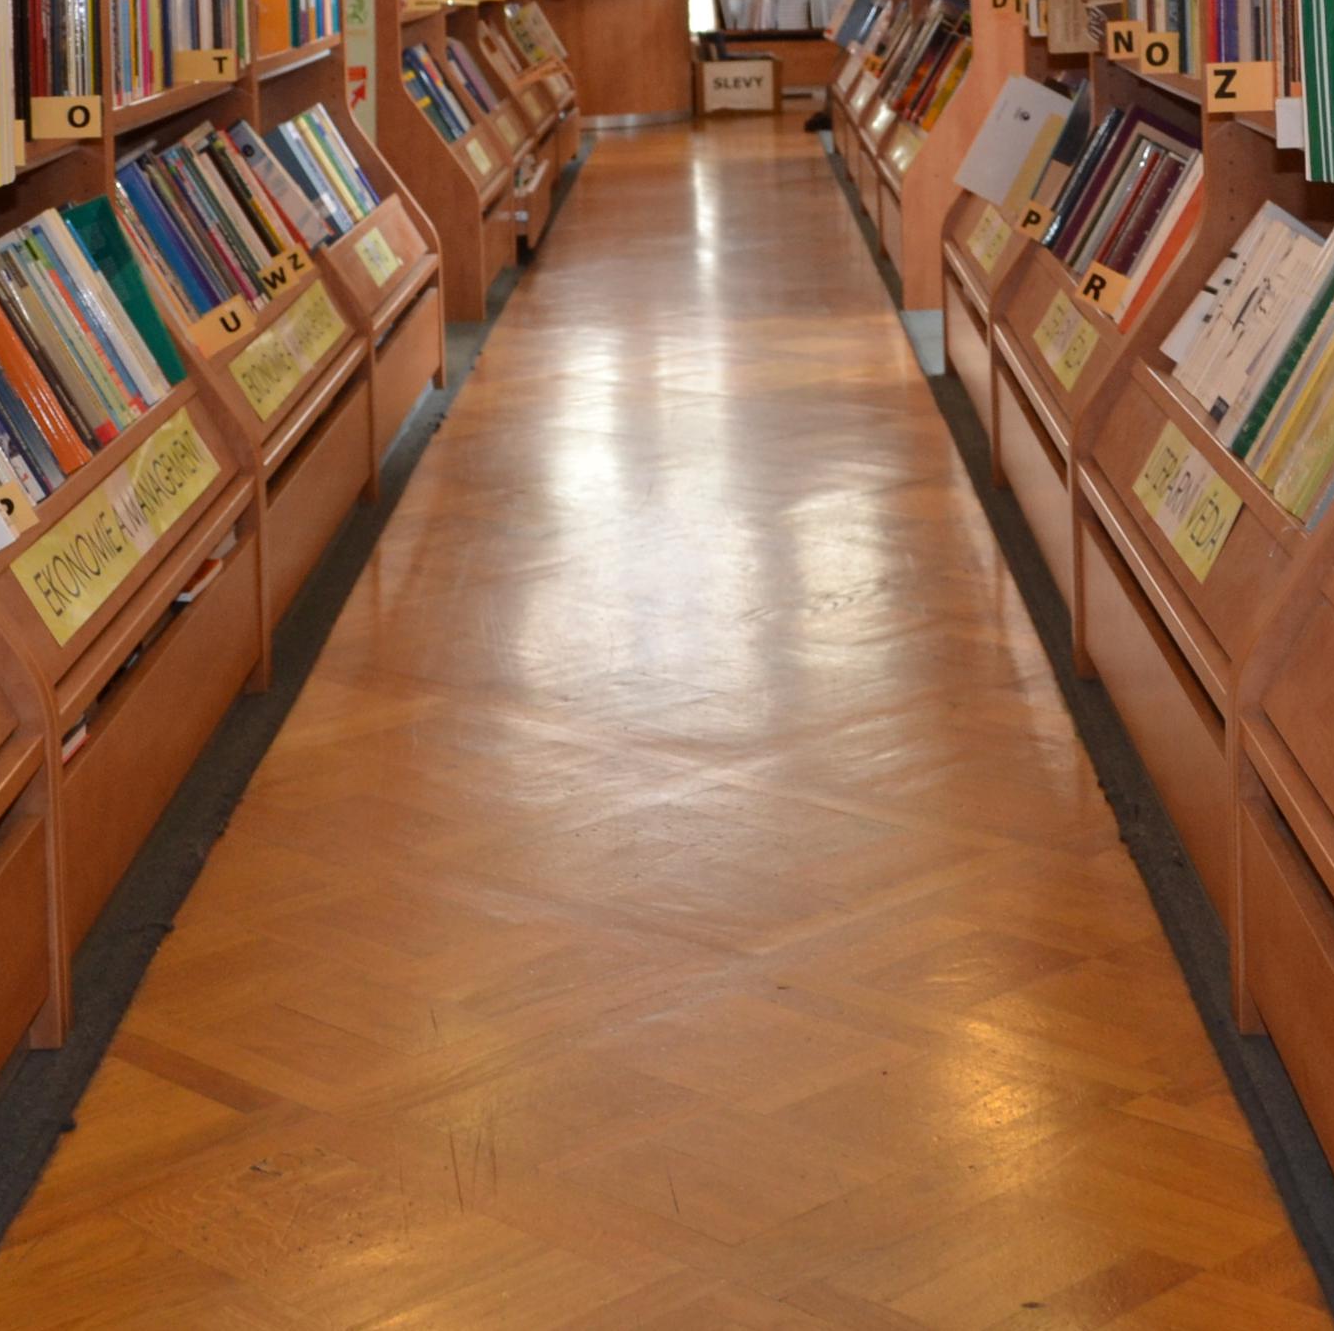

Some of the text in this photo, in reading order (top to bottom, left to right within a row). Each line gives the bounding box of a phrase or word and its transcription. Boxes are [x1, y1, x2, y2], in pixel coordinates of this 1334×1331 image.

[1113, 31, 1134, 53] N
[213, 56, 228, 75] T
[1146, 42, 1169, 67] O
[713, 76, 765, 92] SLEVY
[1213, 70, 1237, 100] Z
[67, 106, 90, 130] O
[1021, 212, 1041, 230] P
[290, 254, 305, 271] Z
[264, 267, 287, 300] W
[1082, 277, 1107, 302] R
[221, 315, 241, 335] U
[34, 512, 123, 616] EKONOMIE
[123, 430, 203, 539] MANAGEMENT
